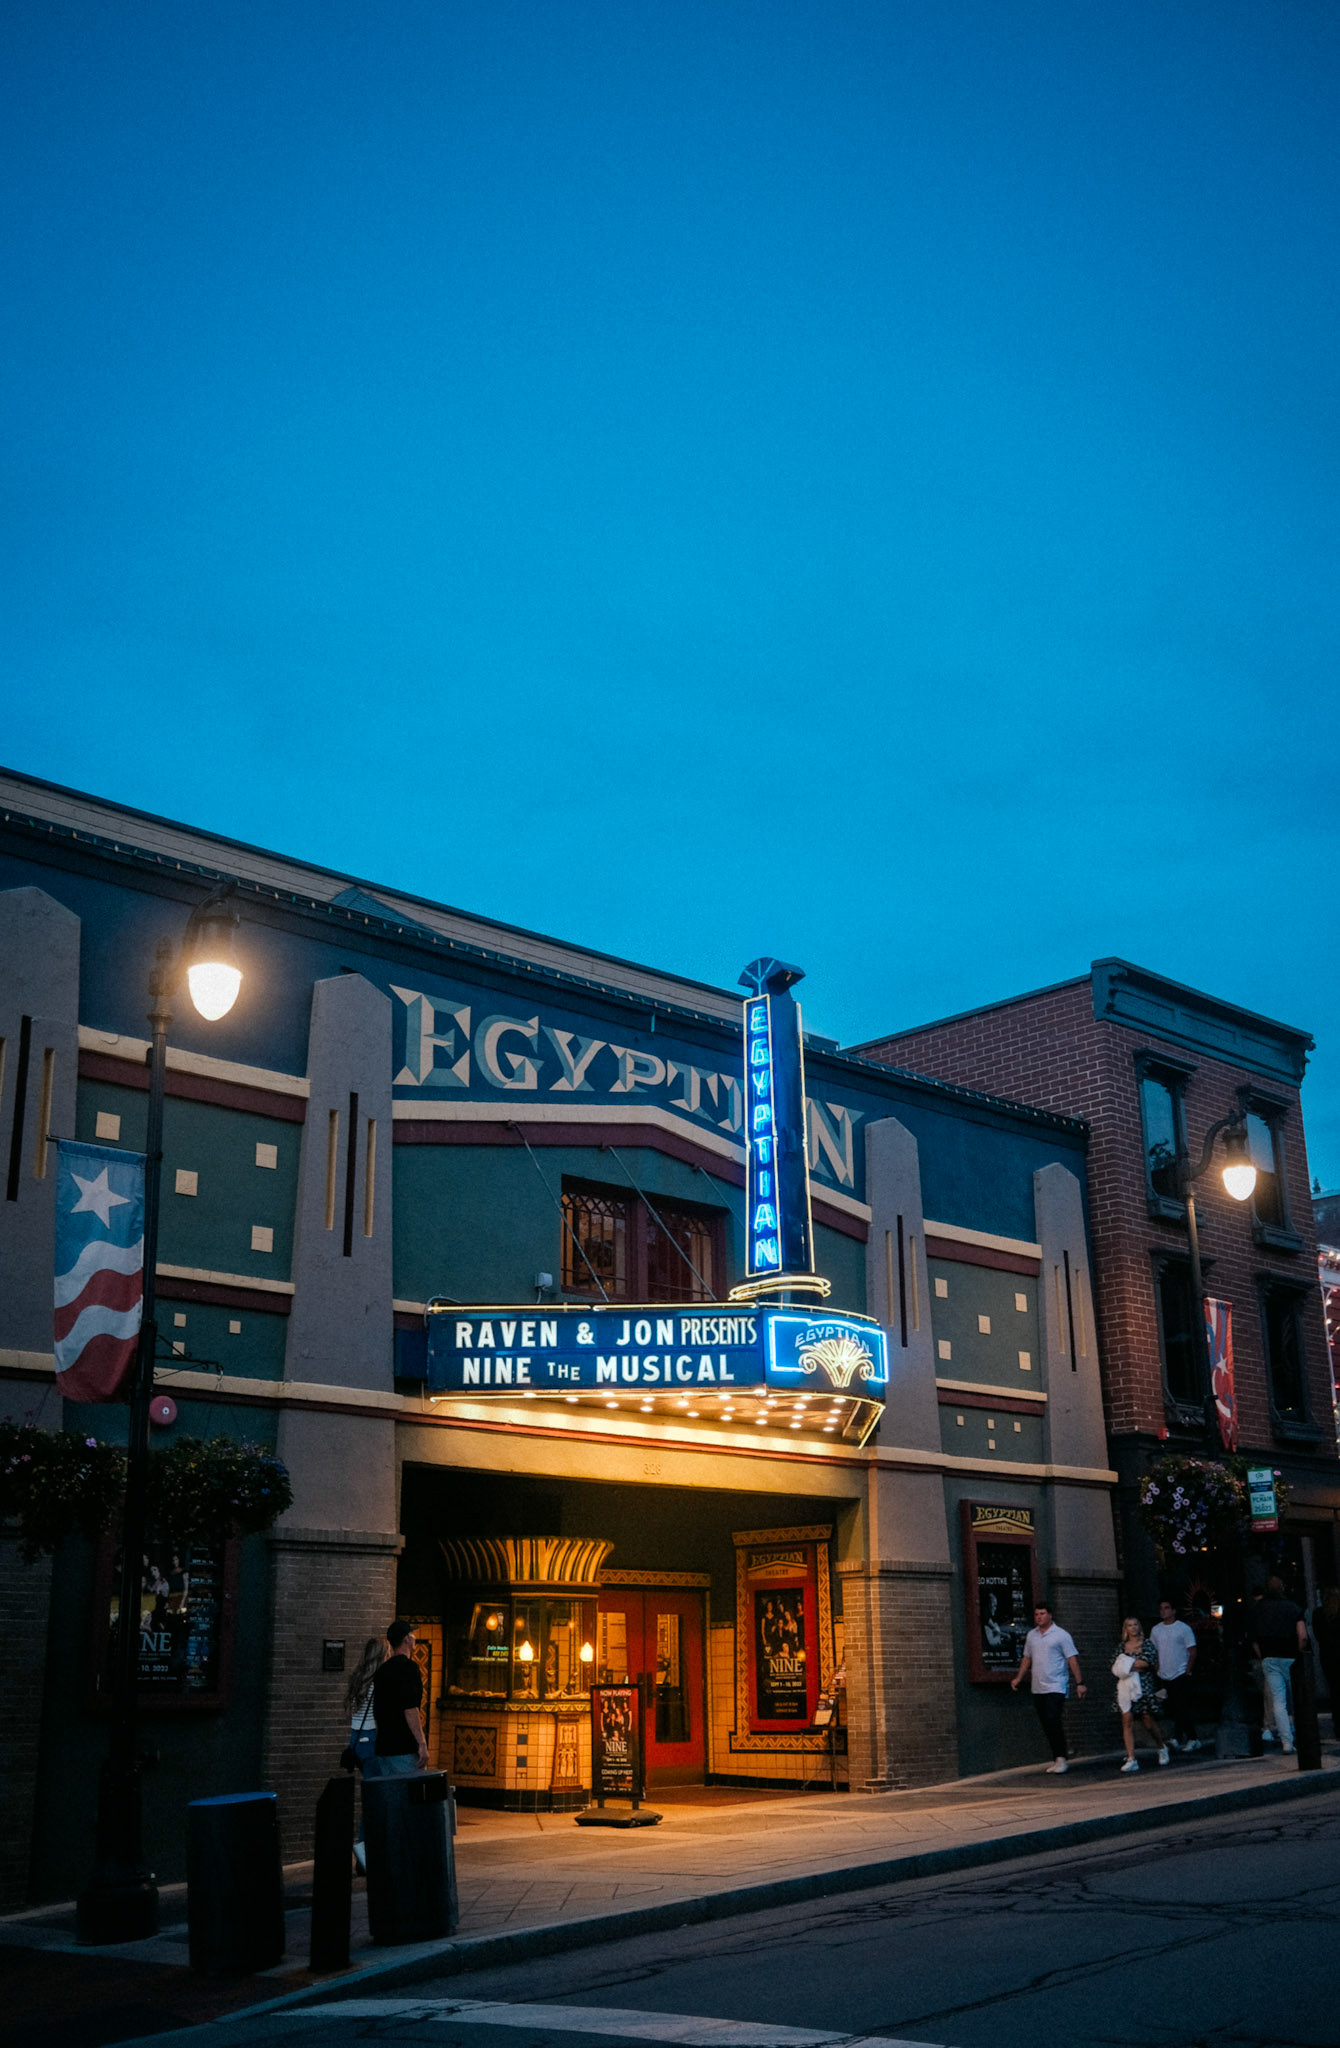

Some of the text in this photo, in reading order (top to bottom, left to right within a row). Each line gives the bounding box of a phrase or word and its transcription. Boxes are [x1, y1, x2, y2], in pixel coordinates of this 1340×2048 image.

[389, 983, 864, 1189] EGYPTIN
[751, 1005, 778, 1268] EGYPTIAN
[456, 1317, 757, 1348] RAVEN & JON PRESENTS
[795, 1326, 870, 1354] EGYPTIAN
[462, 1354, 734, 1384] NINE THE MUSICAL
[976, 1506, 1030, 1524] EGYPTIAN
[752, 1552, 803, 1567] EGYPTIAN
[139, 1631, 172, 1652] NE
[769, 1658, 803, 1673] NINE
[605, 1741, 628, 1752] NINE
